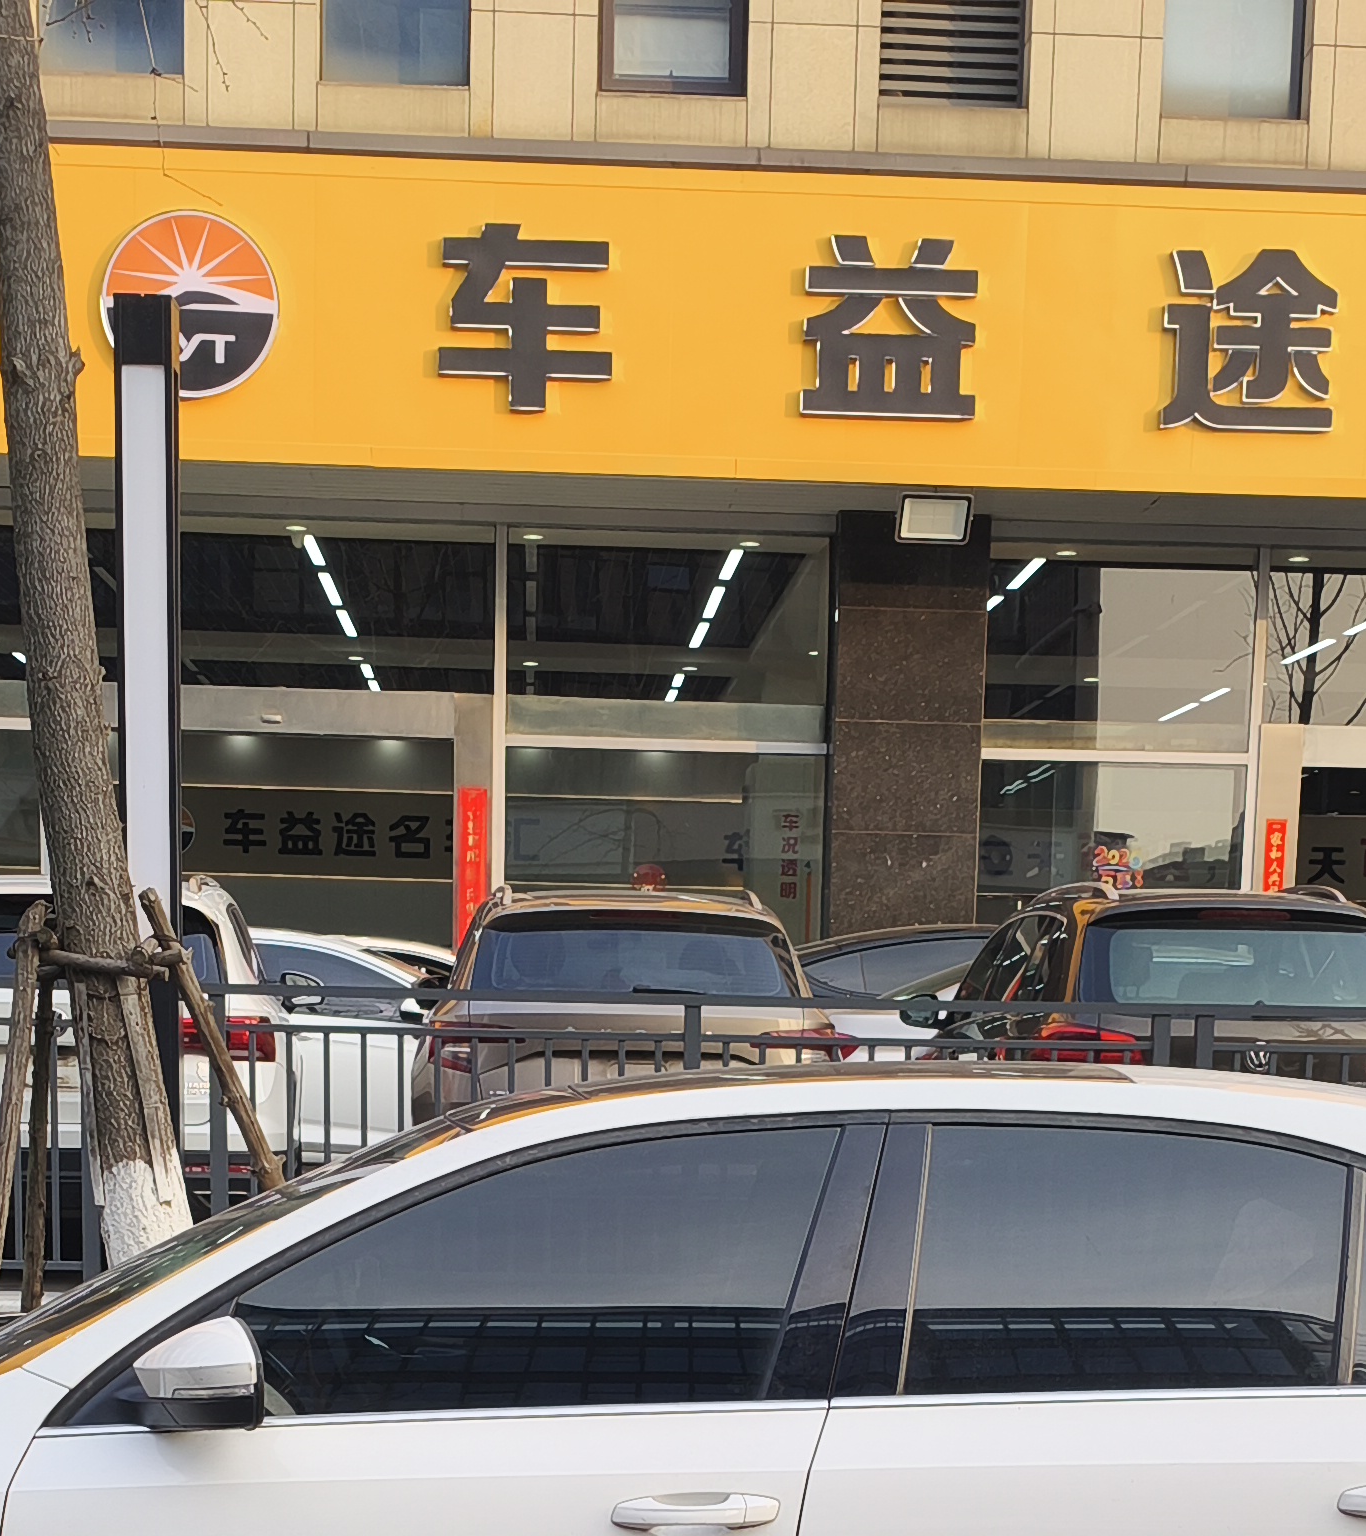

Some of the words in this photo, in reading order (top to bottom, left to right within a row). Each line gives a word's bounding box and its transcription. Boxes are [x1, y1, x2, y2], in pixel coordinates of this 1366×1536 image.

[437, 222, 1339, 433] 车益途
[779, 813, 800, 900] 车况透明
